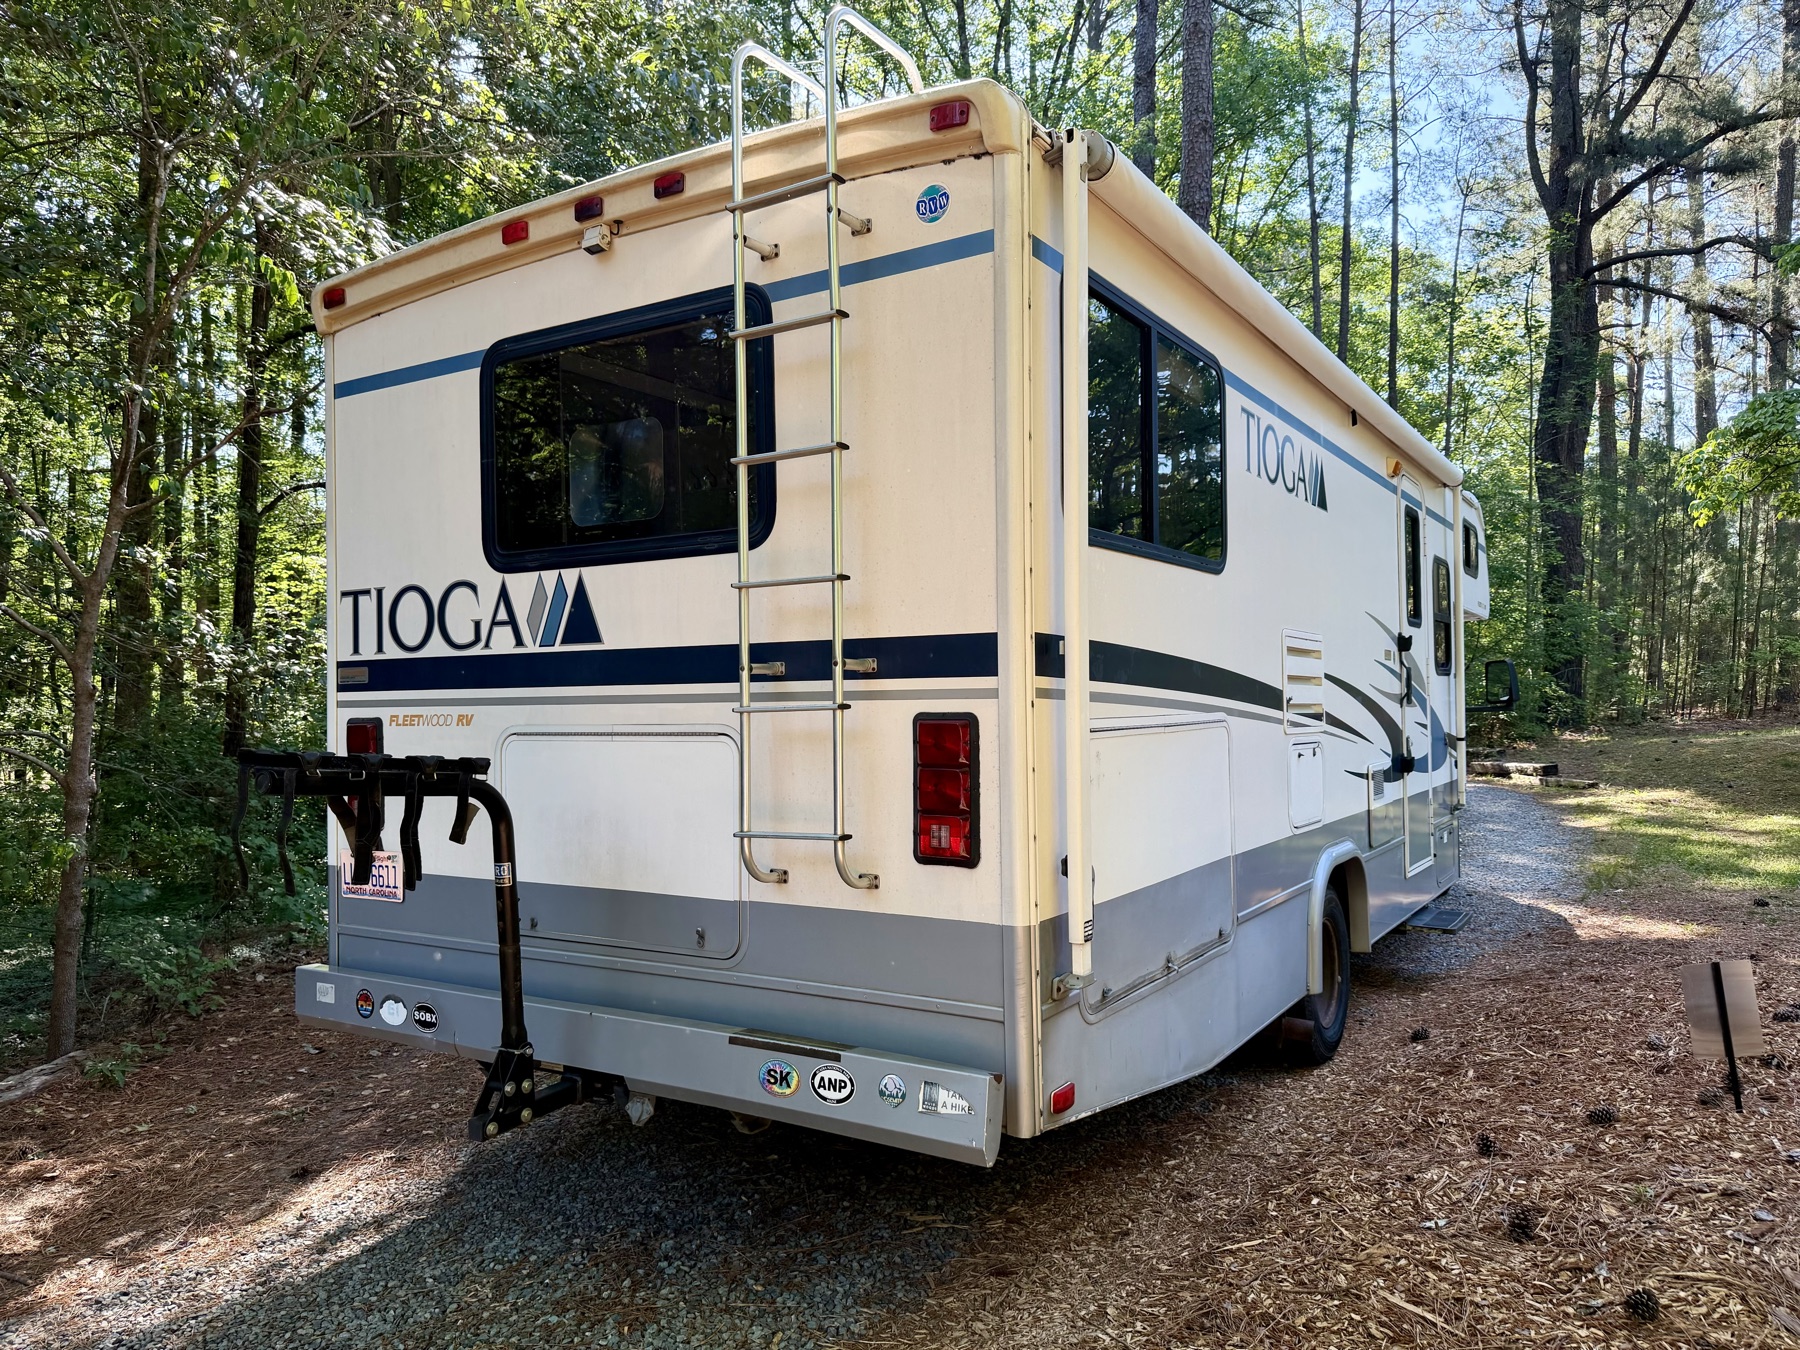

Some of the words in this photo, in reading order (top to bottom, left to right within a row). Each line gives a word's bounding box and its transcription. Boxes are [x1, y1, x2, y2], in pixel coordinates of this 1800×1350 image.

[918, 193, 948, 215] RVW
[1240, 404, 1309, 504] TIOGA
[339, 573, 529, 657] TIOGA
[389, 713, 454, 727] FLEETWOOD
[456, 713, 475, 727] RV
[345, 885, 368, 896] NORTH
[368, 888, 398, 898] CAROLINA
[413, 1010, 437, 1025] SOBX
[765, 1068, 792, 1089] SK
[817, 1075, 848, 1094] ANP
[941, 1100, 948, 1110] A
